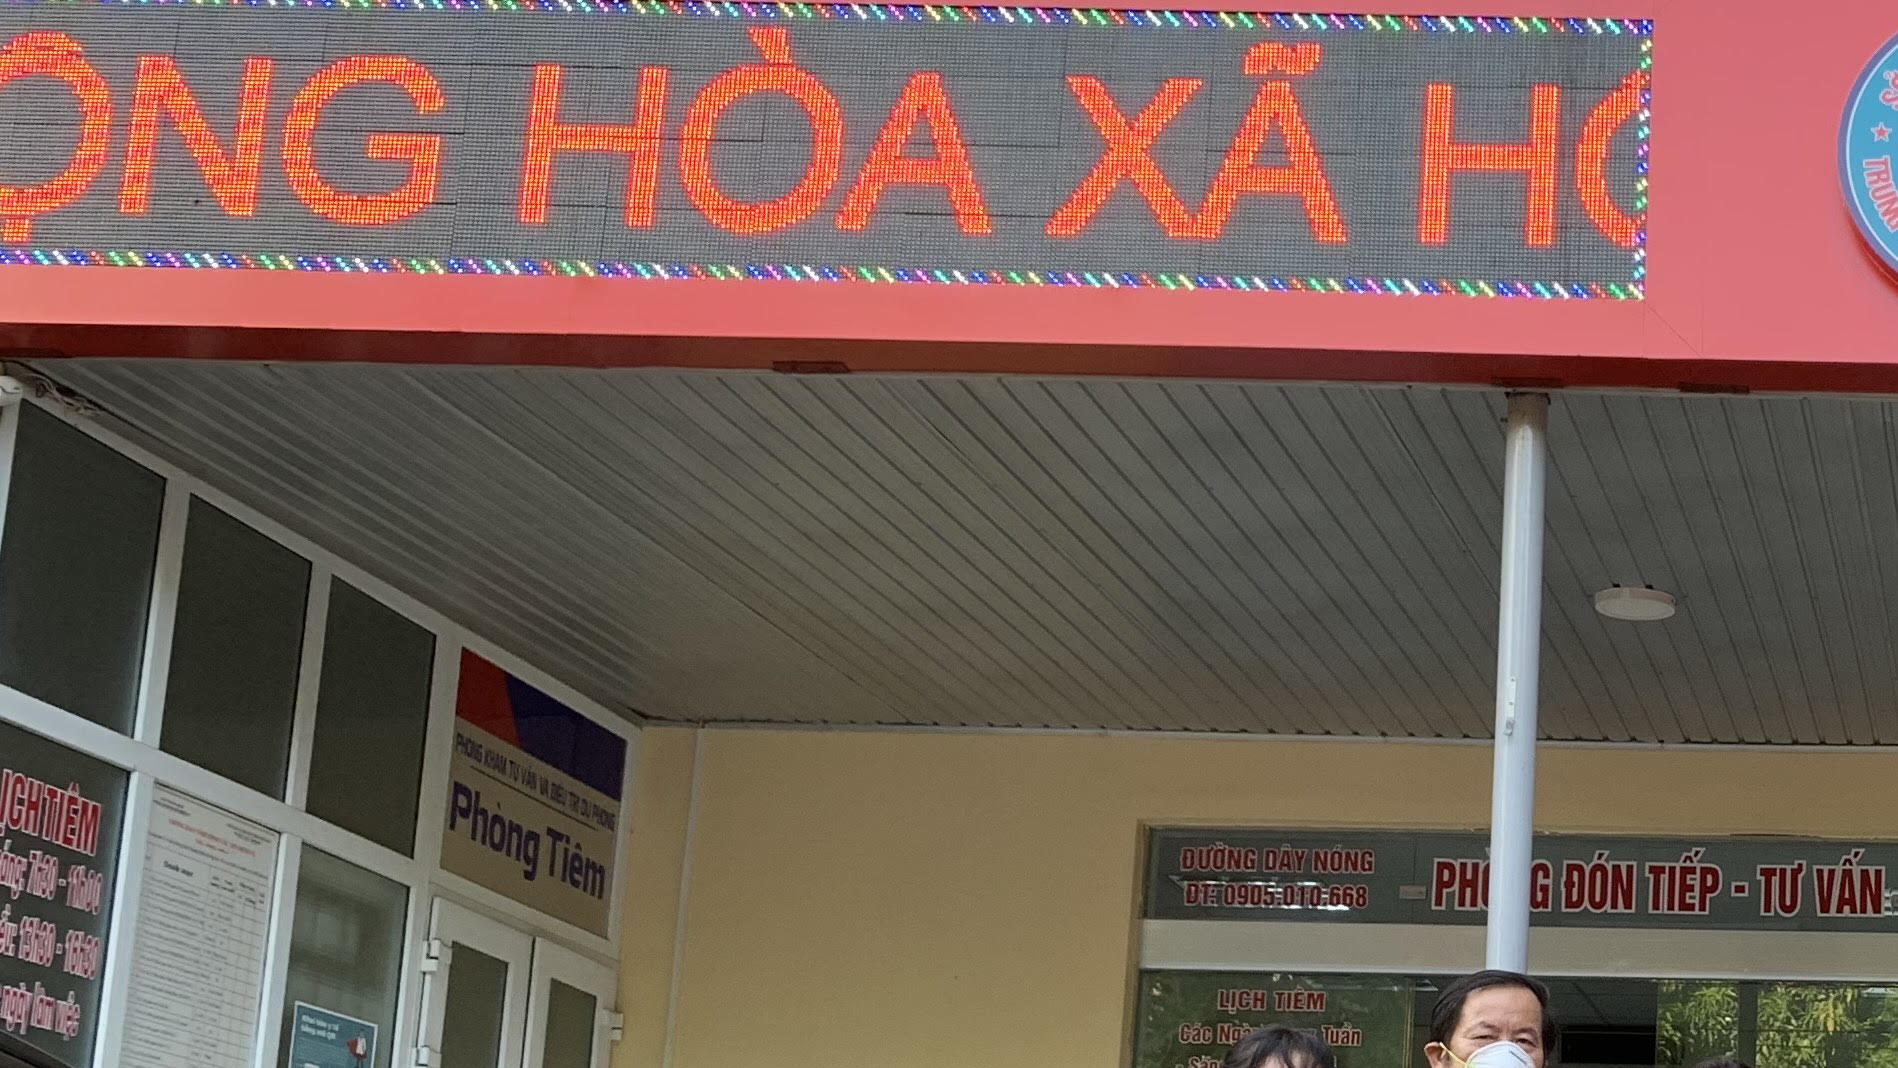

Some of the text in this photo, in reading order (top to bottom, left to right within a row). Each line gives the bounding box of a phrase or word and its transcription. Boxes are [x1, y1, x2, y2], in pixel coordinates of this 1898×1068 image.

[517, 26, 993, 236] HÒA
[1043, 41, 1349, 243] XÃ
[42, 781, 101, 857] TIÊM
[449, 781, 606, 900] Phòng Tiêm
[27, 850, 58, 900] 7h30
[1180, 844, 1375, 874] ĐƯỜNG DÂY NÓNG
[1431, 847, 1553, 912] PHG
[1561, 851, 1637, 915] ĐÓN
[1645, 847, 1722, 915] TIẾP
[1756, 860, 1807, 917] TƯ
[1814, 848, 1886, 917] VẤN
[1217, 985, 1326, 1014] LỊCH TIÊM
[1179, 1022, 1212, 1044] Các
[1321, 1021, 1362, 1047] Tuần
